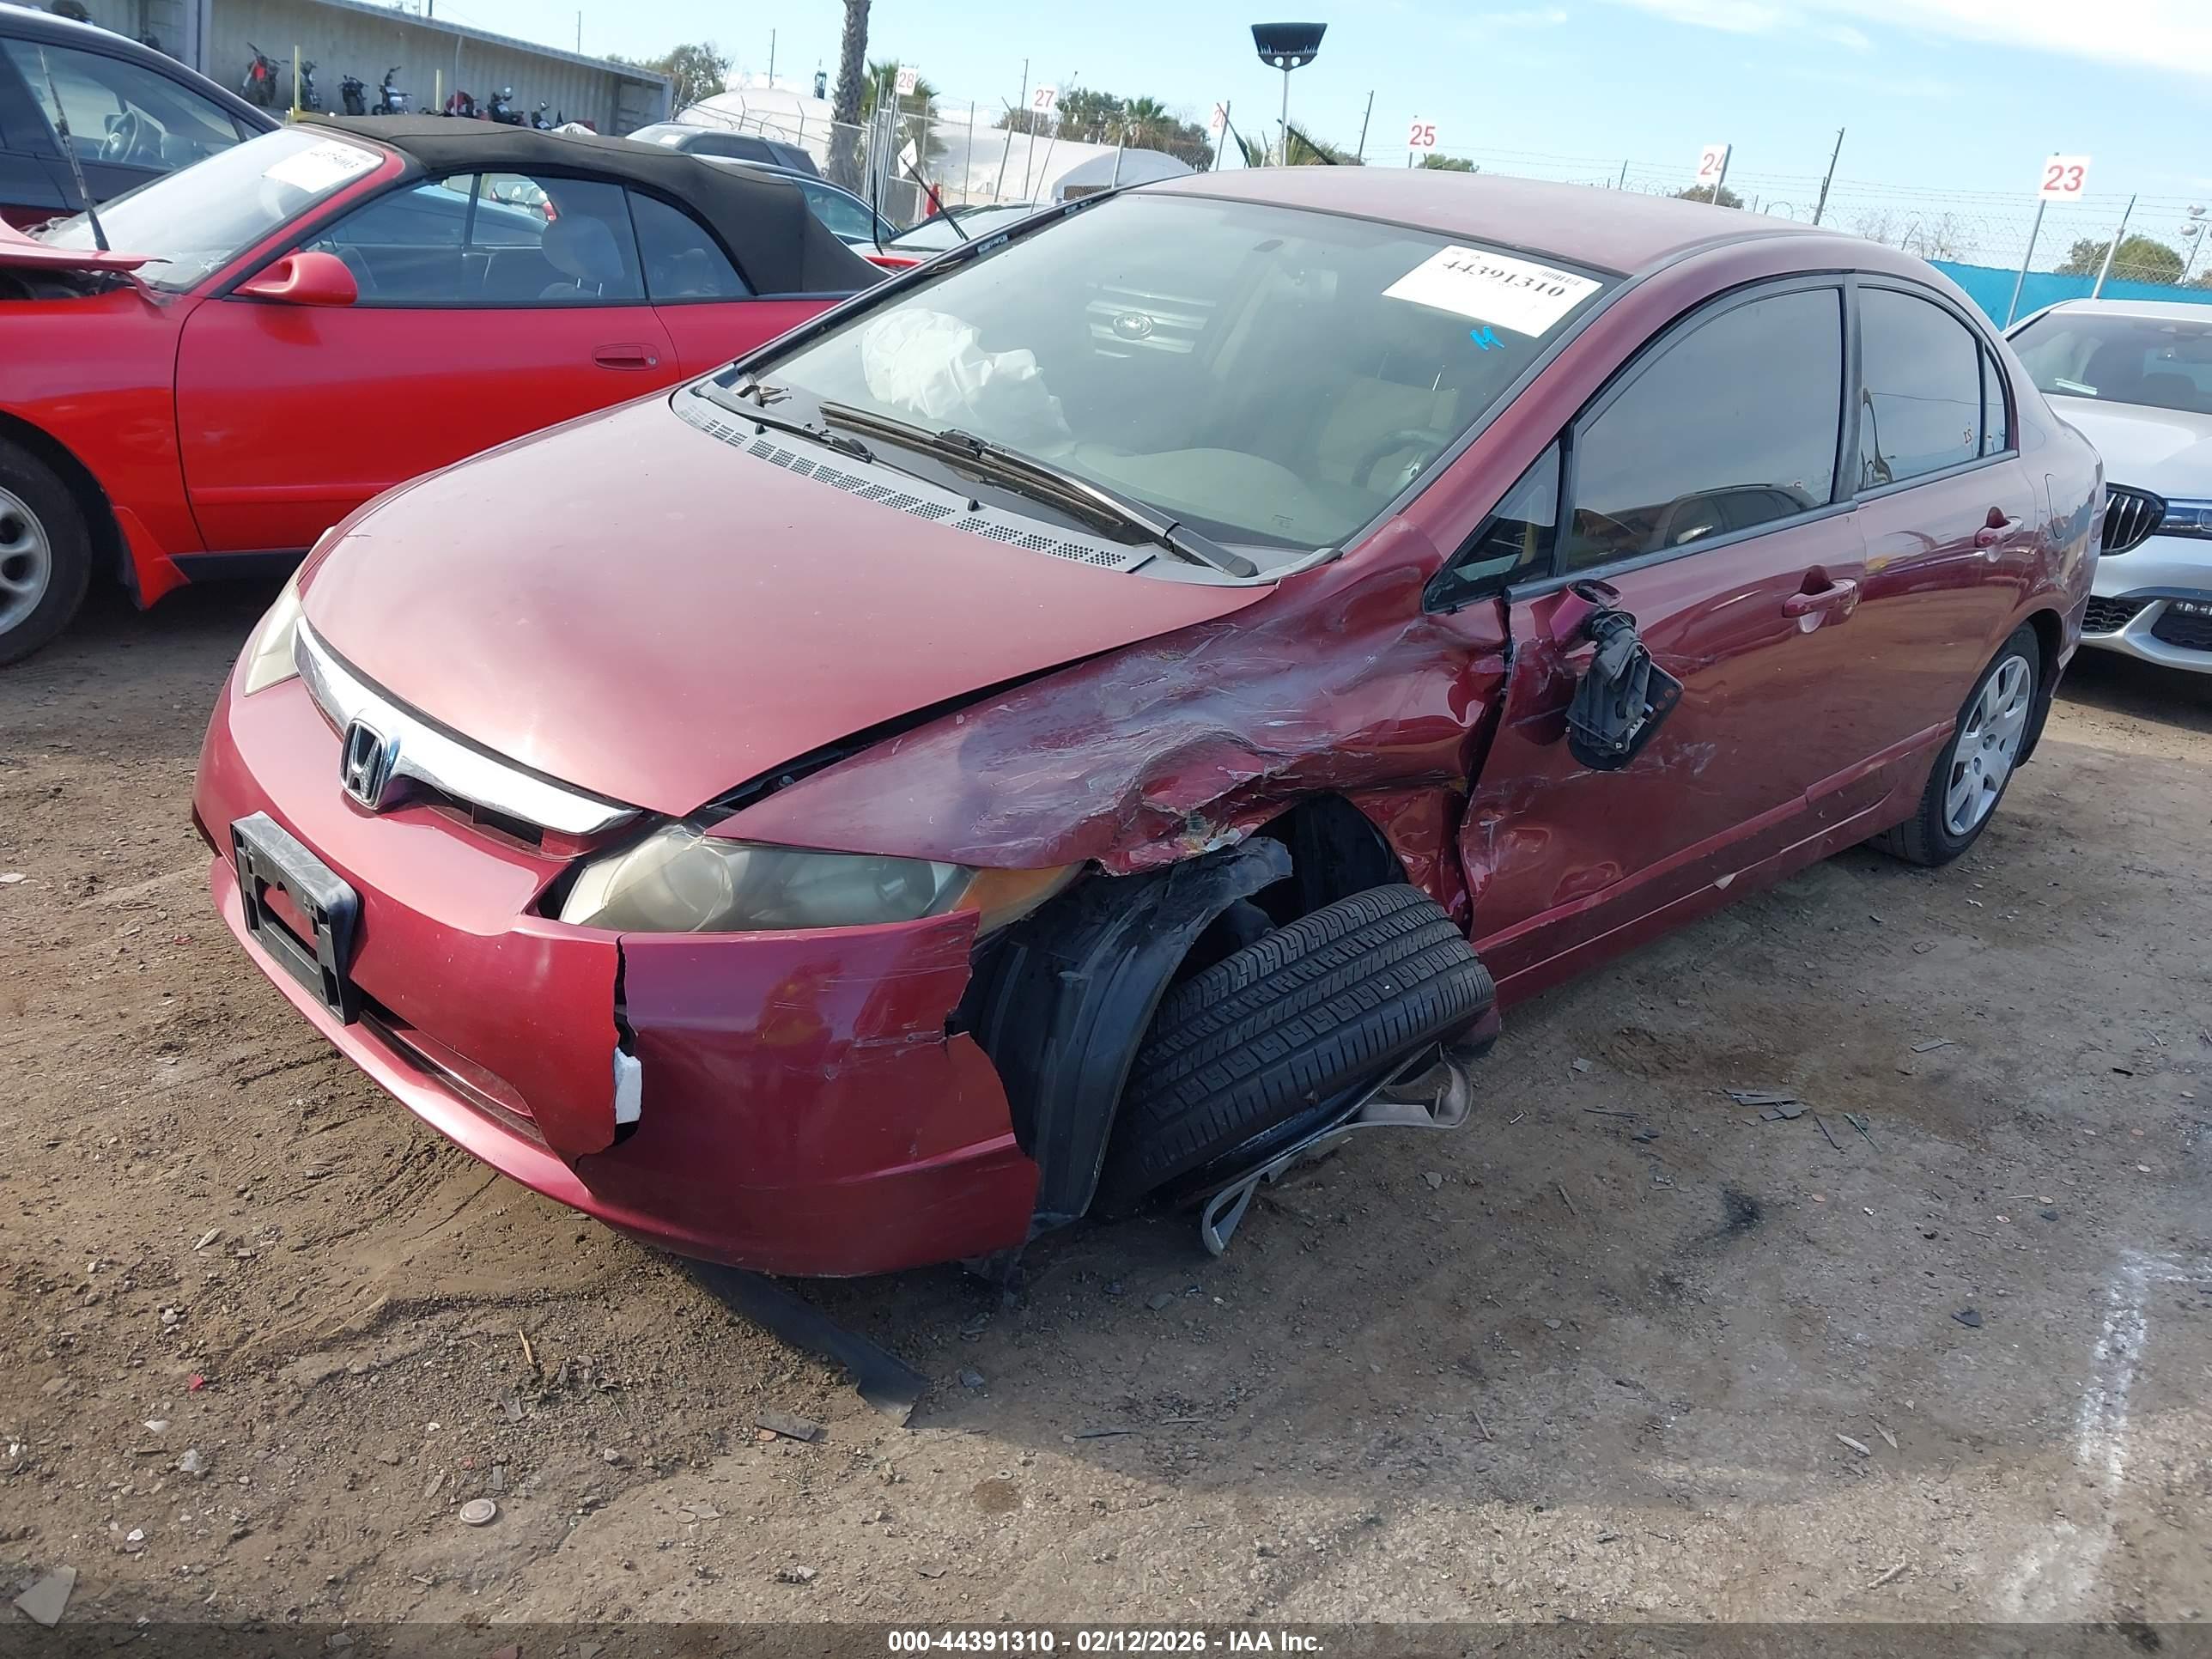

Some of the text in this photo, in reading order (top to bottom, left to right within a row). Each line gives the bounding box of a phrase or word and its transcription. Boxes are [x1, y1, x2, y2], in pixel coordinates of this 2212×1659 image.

[897, 71, 915, 89] 28
[1034, 88, 1055, 108] 27
[1409, 125, 1436, 147] 25
[2043, 164, 2085, 191] 23
[1442, 259, 1567, 298] 44391310
